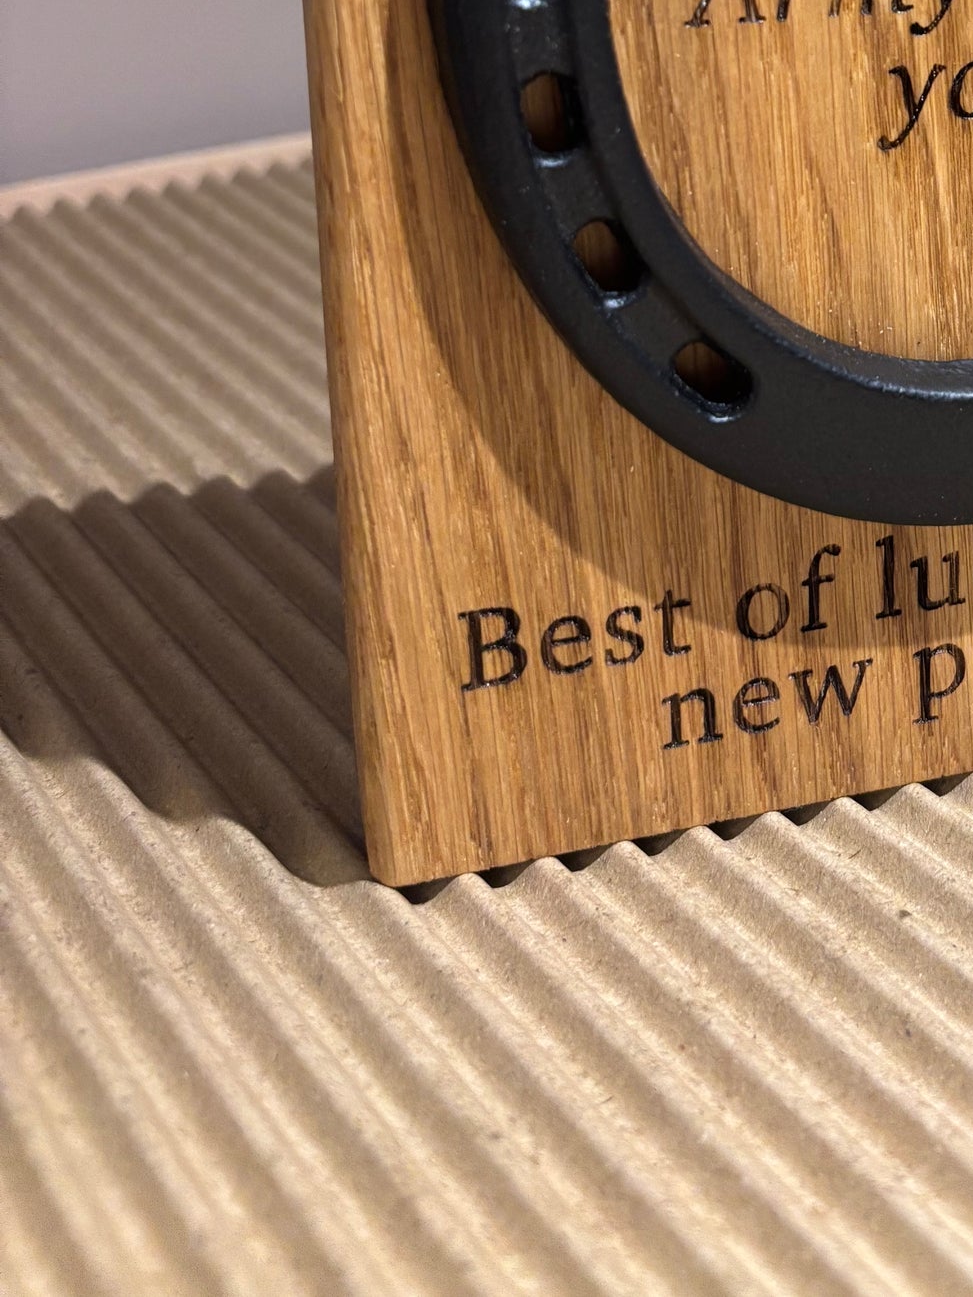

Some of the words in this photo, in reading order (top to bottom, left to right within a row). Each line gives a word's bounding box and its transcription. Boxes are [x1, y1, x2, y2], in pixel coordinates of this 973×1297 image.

[458, 589, 691, 692] Best
[736, 543, 841, 641] of
[660, 657, 874, 750] new
